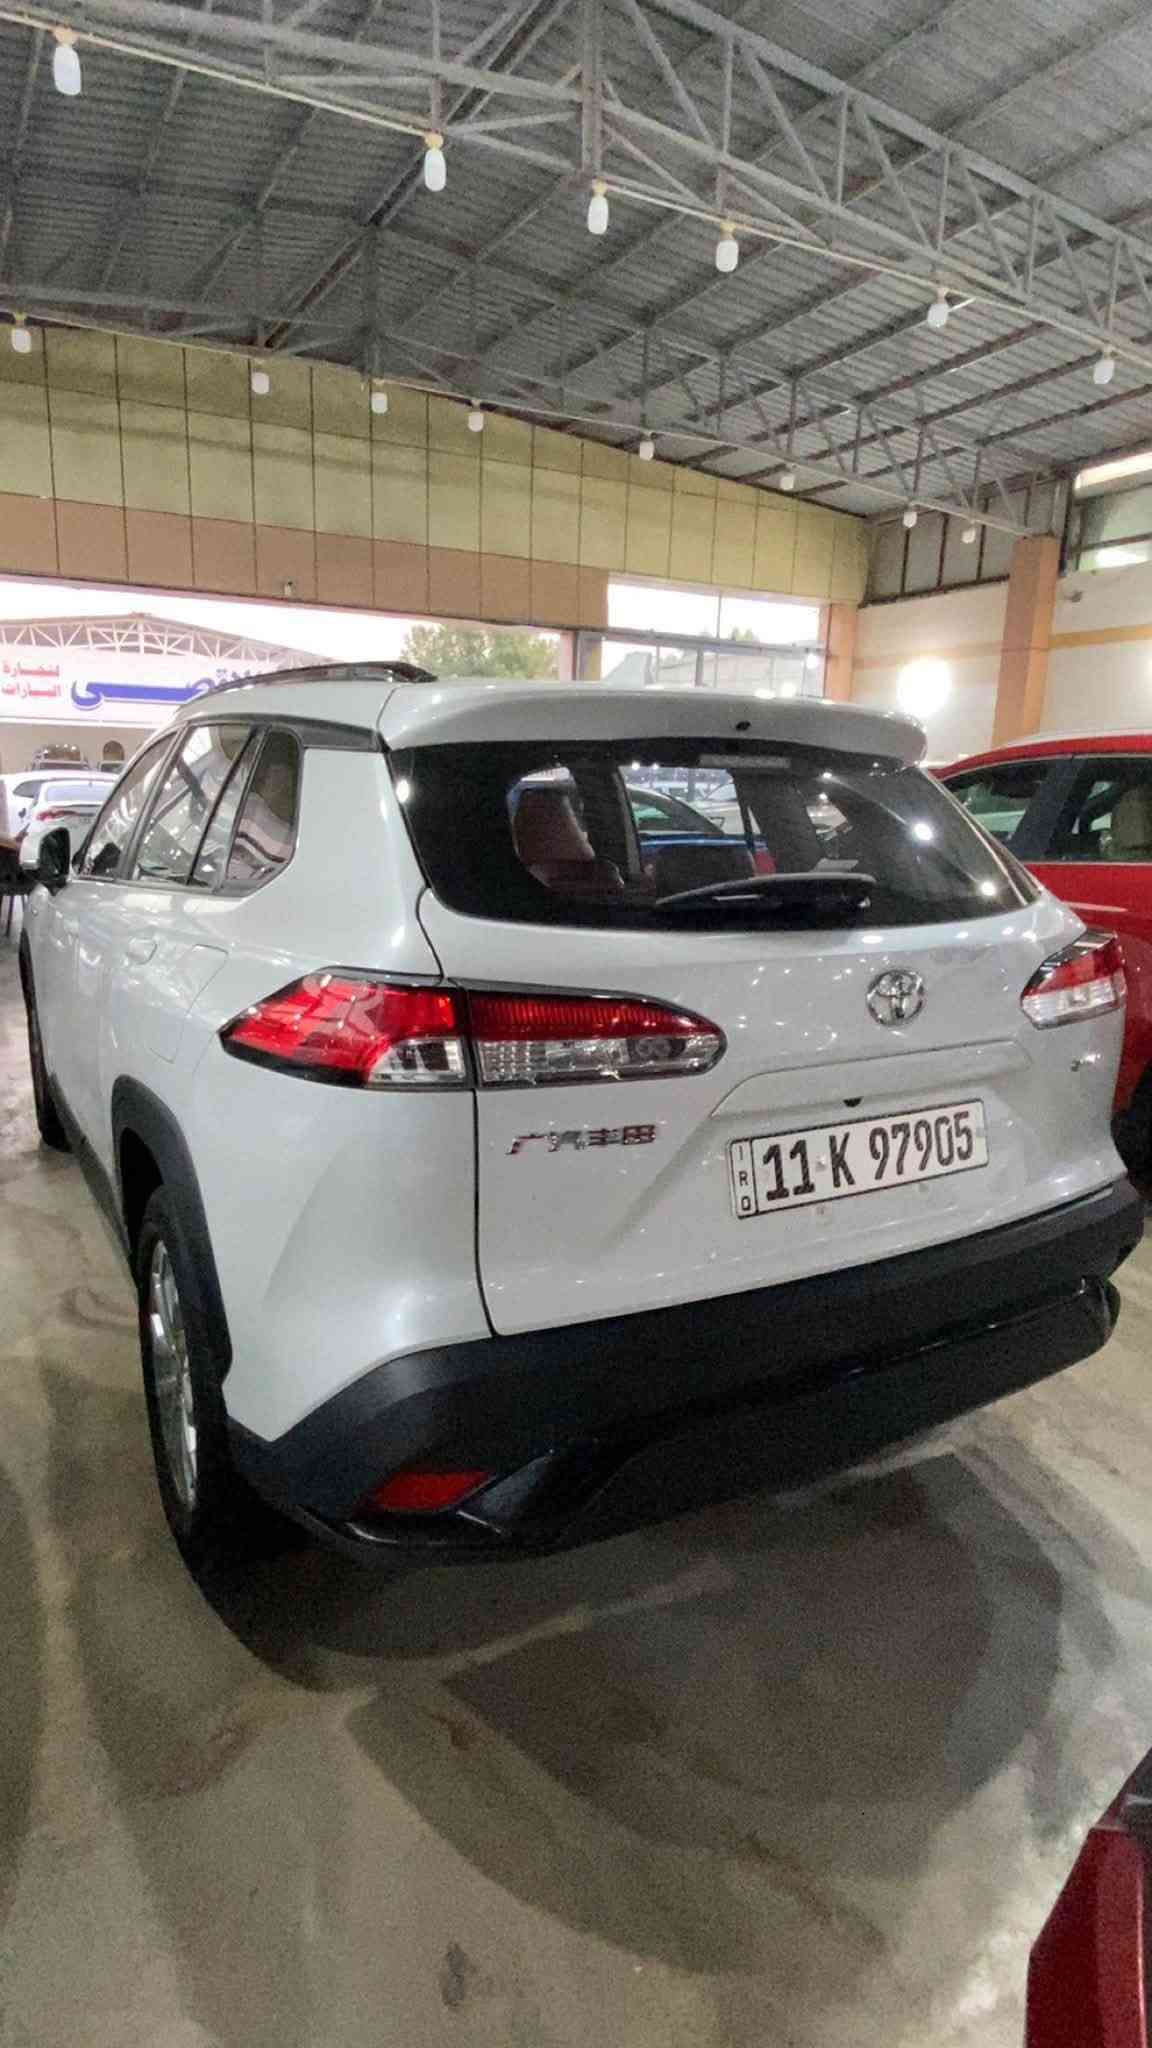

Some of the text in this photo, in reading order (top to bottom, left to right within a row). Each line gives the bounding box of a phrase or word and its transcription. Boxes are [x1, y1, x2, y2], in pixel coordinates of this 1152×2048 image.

[762, 1110, 974, 1201] 11 K 97905
